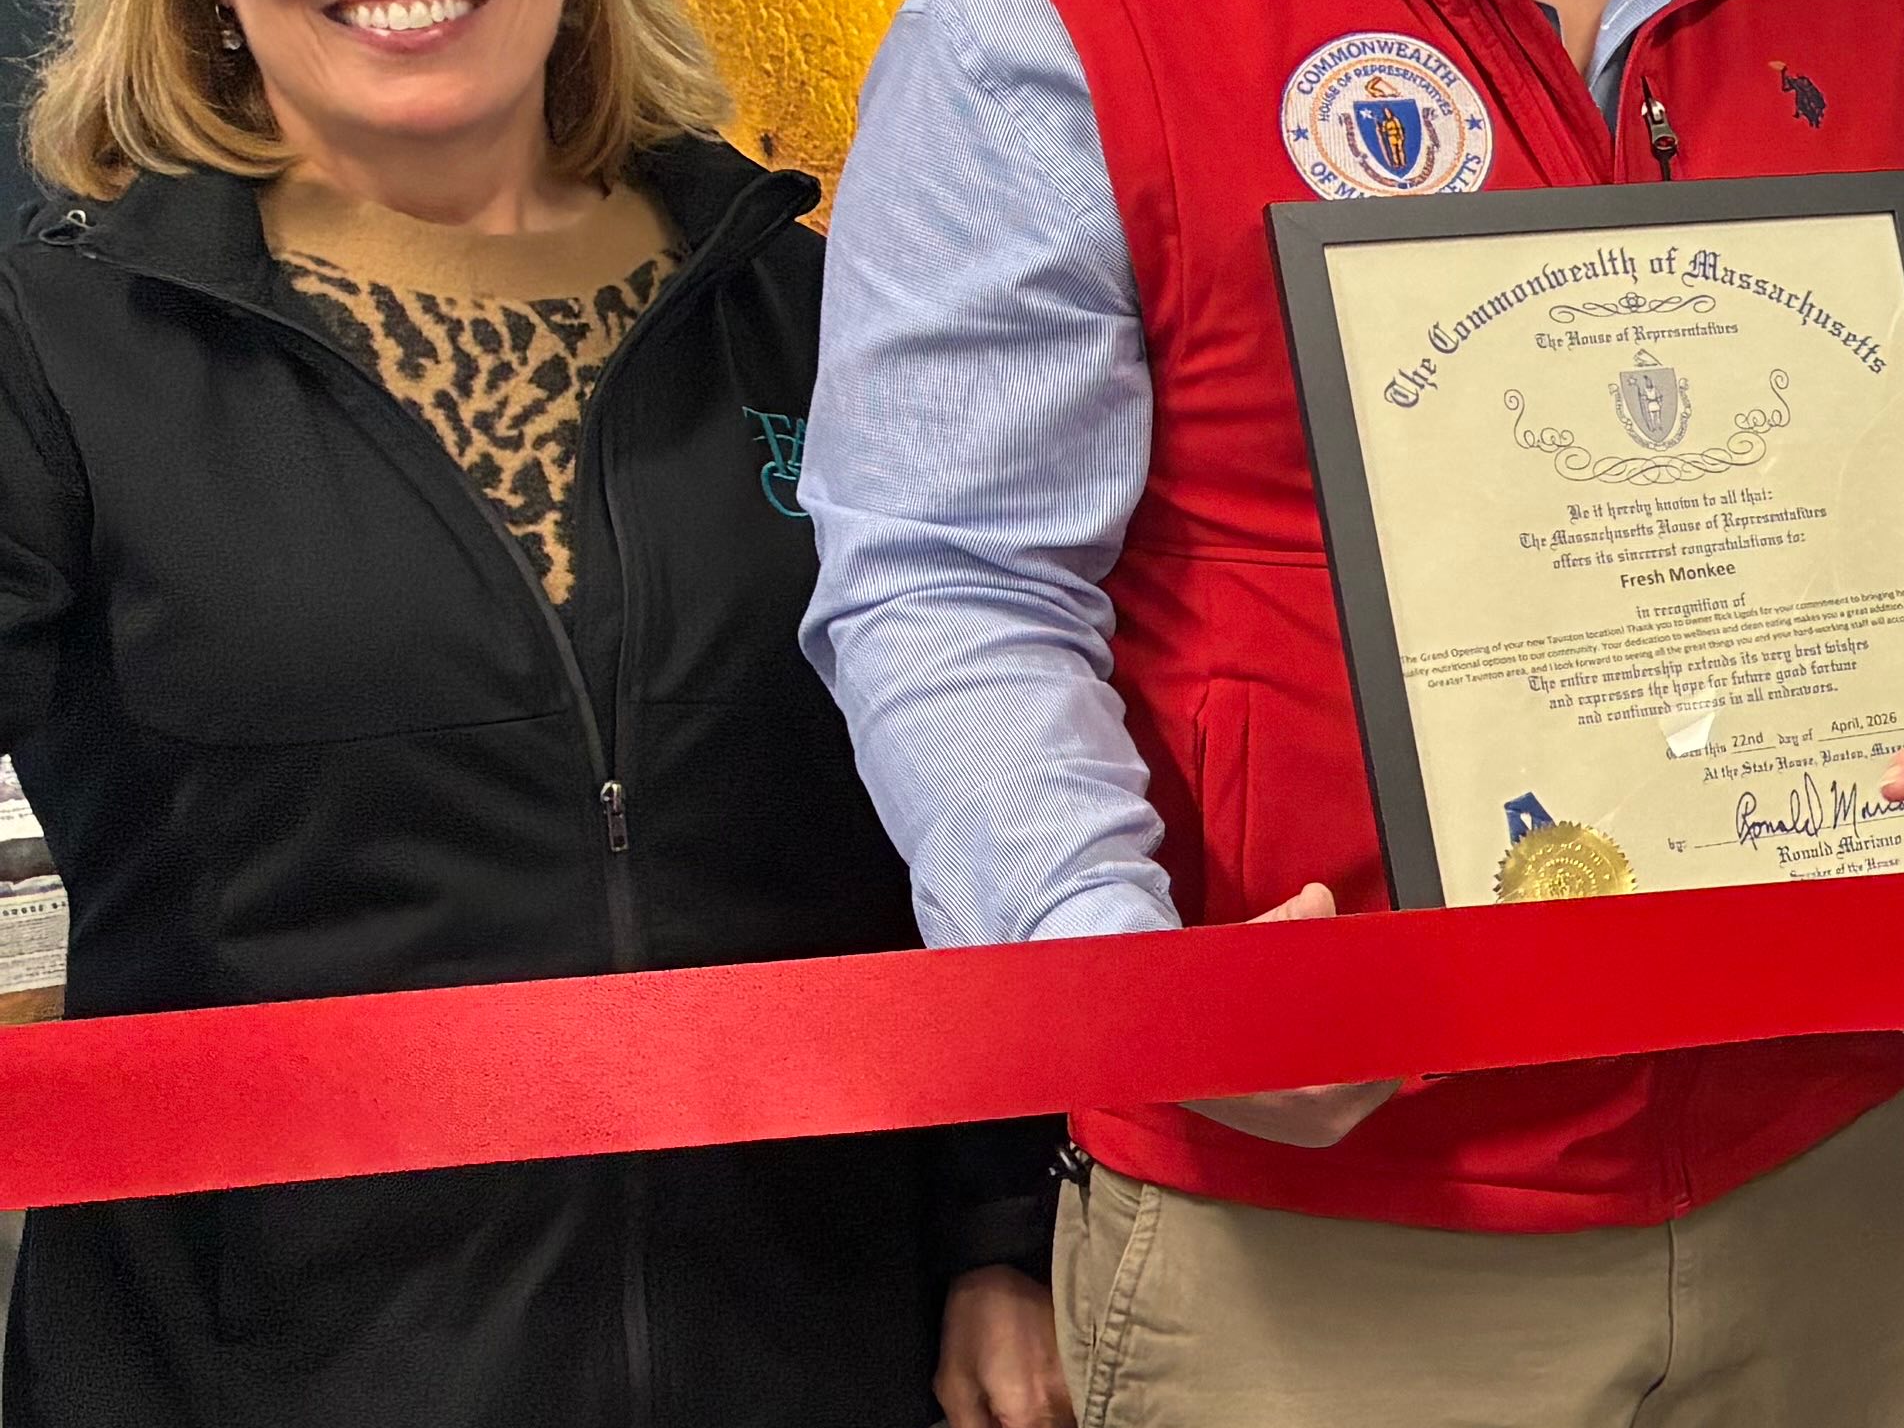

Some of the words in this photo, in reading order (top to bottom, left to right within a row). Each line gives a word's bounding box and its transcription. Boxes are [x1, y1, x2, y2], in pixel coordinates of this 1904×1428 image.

[1297, 39, 1459, 95] COMMONWEALTH
[1318, 84, 1340, 122] HOUSE
[1339, 76, 1352, 87] OF
[1353, 64, 1454, 116] REPRESENTATIVES
[1384, 357, 1439, 410] The
[1428, 248, 1639, 355] Commonwealth
[1650, 248, 1677, 275] of
[1681, 249, 1887, 375] Massachusetts
[1535, 333, 1565, 351] The
[1567, 329, 1612, 348] House
[1616, 327, 1630, 343] of
[1634, 321, 1739, 345] Representatives
[1518, 532, 1547, 550] The
[1549, 523, 1654, 548] Massachusetts
[1655, 518, 1701, 539] House
[1705, 513, 1719, 530] of
[1720, 506, 1828, 533] Representatives
[1620, 569, 1666, 589] Fresh
[1668, 562, 1737, 582] Monkee
[1831, 715, 1864, 733] April,
[1866, 712, 1898, 727] 2026
[1732, 733, 1764, 748] 22nd
[1777, 841, 1833, 864] Ronald
[1837, 834, 1902, 858] Mariano
